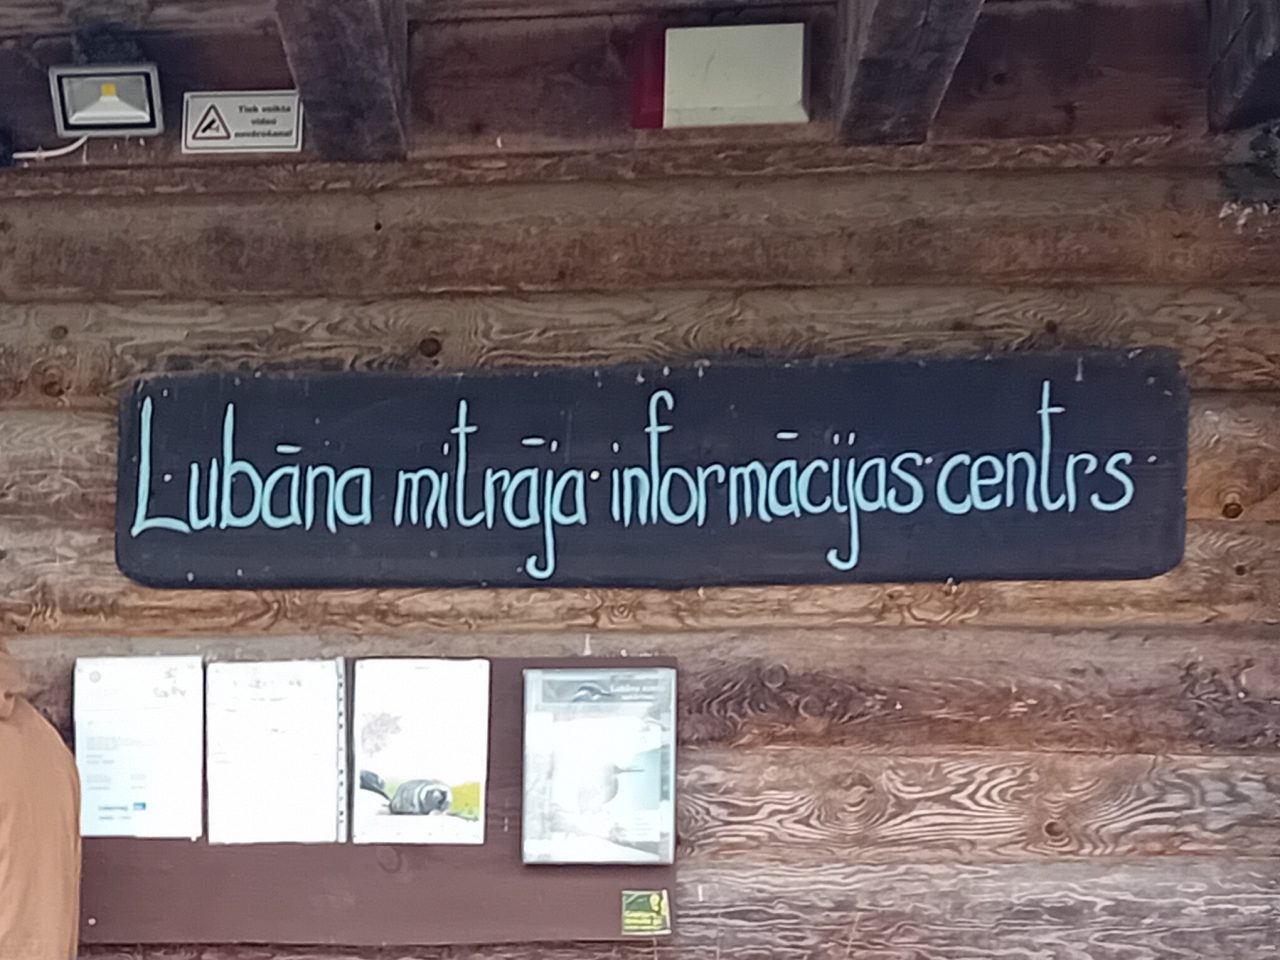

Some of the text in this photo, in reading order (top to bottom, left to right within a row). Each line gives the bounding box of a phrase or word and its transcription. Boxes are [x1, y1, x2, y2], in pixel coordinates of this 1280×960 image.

[130, 379, 1135, 580] Lubāna mitrāja informācijas centrs
